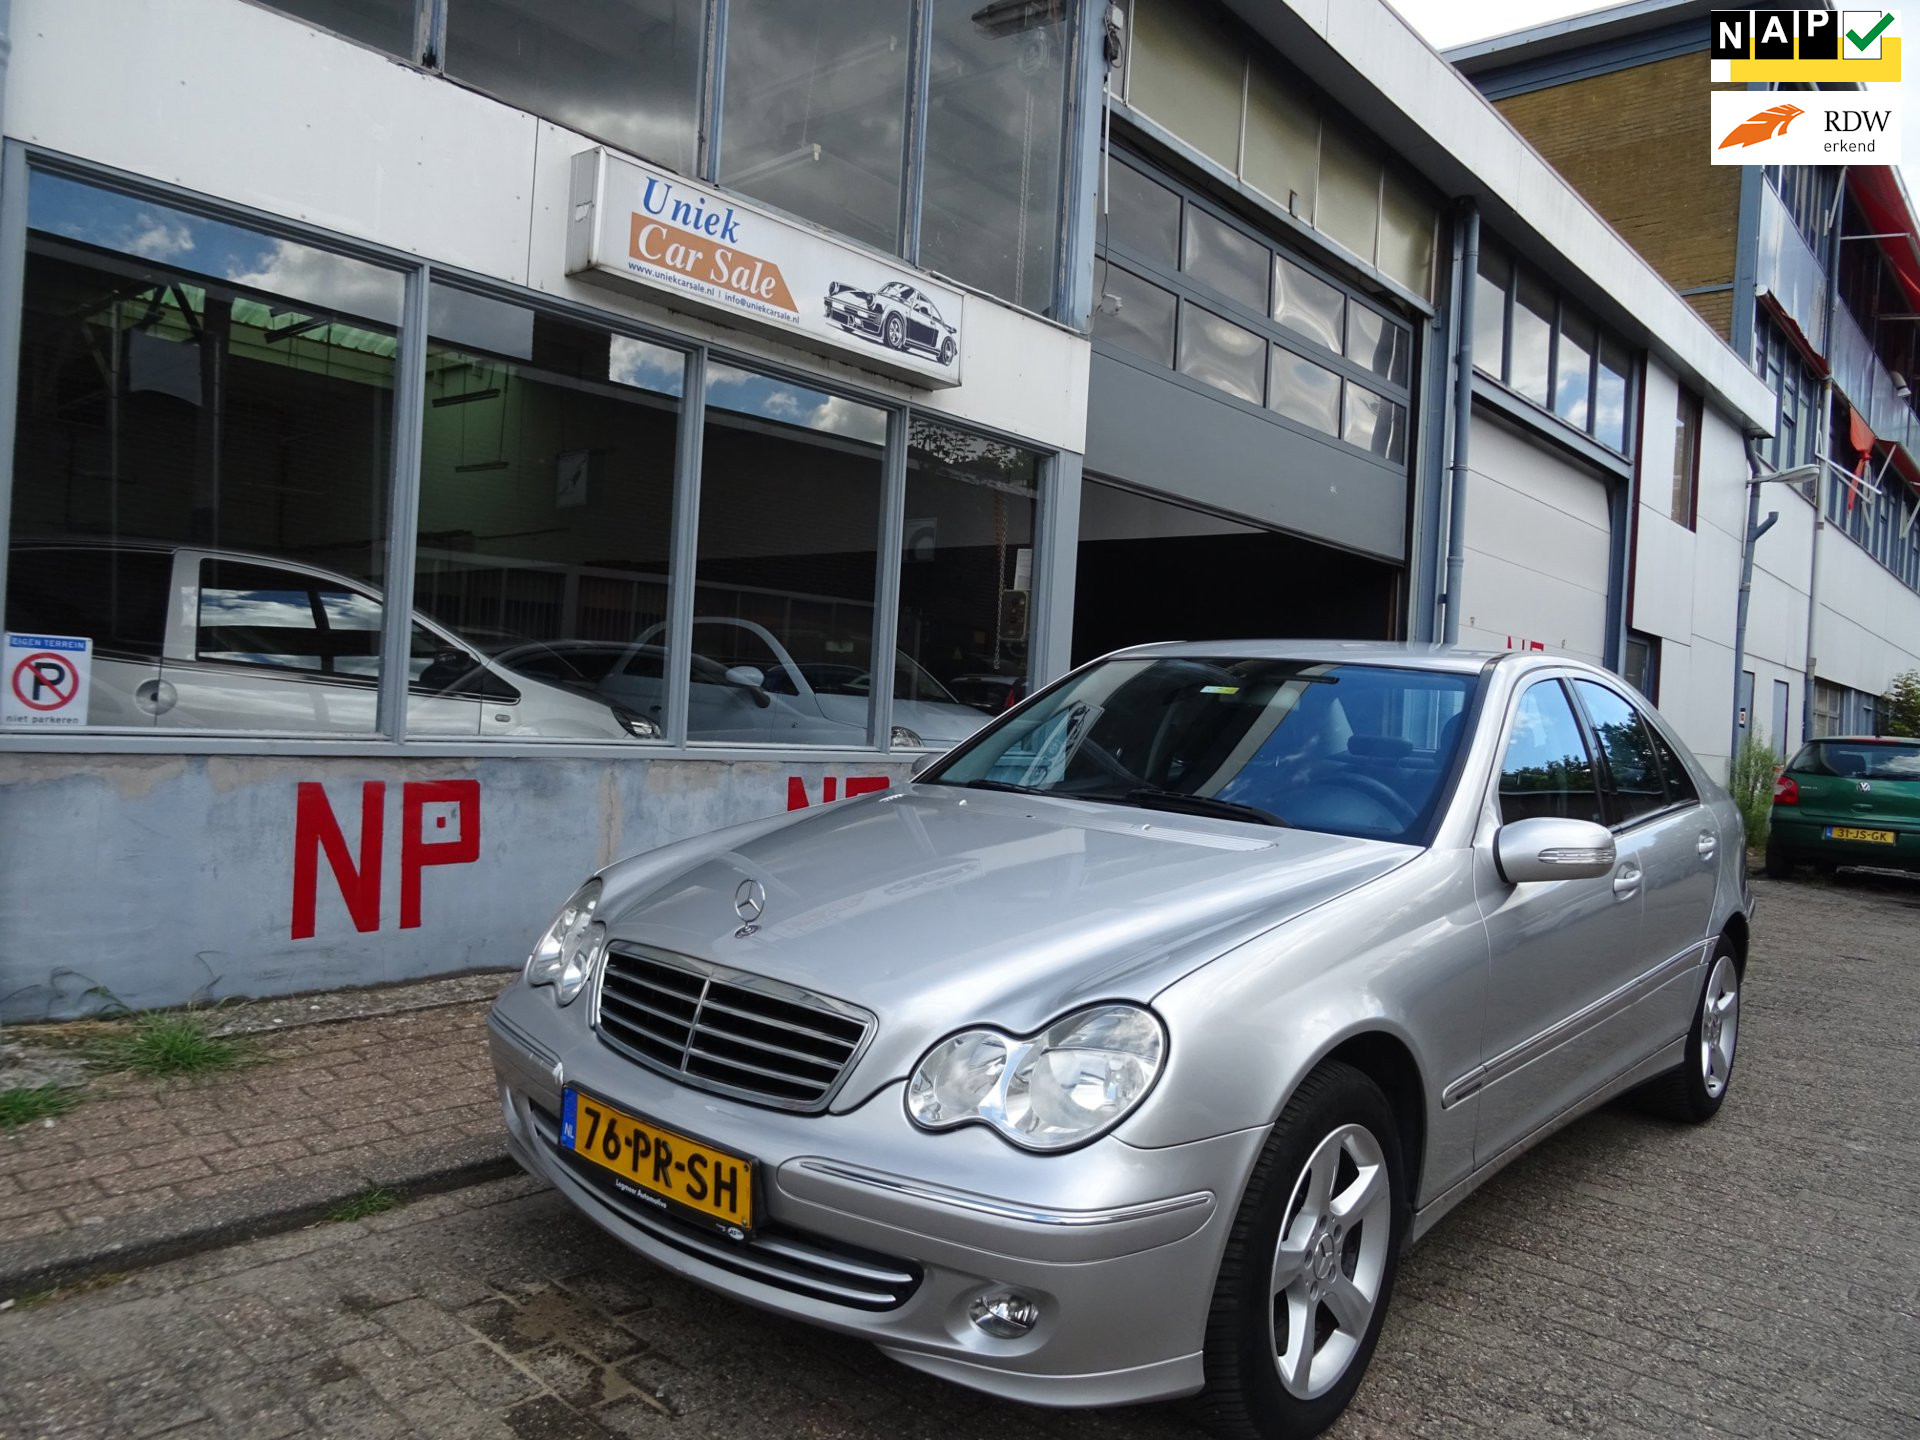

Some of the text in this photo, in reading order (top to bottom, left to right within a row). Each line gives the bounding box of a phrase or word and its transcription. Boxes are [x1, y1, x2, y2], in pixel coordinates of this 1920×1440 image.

[643, 176, 740, 244] Uniek
[628, 261, 800, 324] www.uniekcarsale.nl info@uniekcarsale.nl
[638, 223, 776, 299] Car Sale
[11, 636, 85, 649] EIGEN TERREIN
[6, 715, 79, 725] niet parkeren
[291, 779, 481, 941] NP
[1837, 828, 1888, 842] 31-JS-GK
[563, 1106, 738, 1213] NL 76-PR-SH
